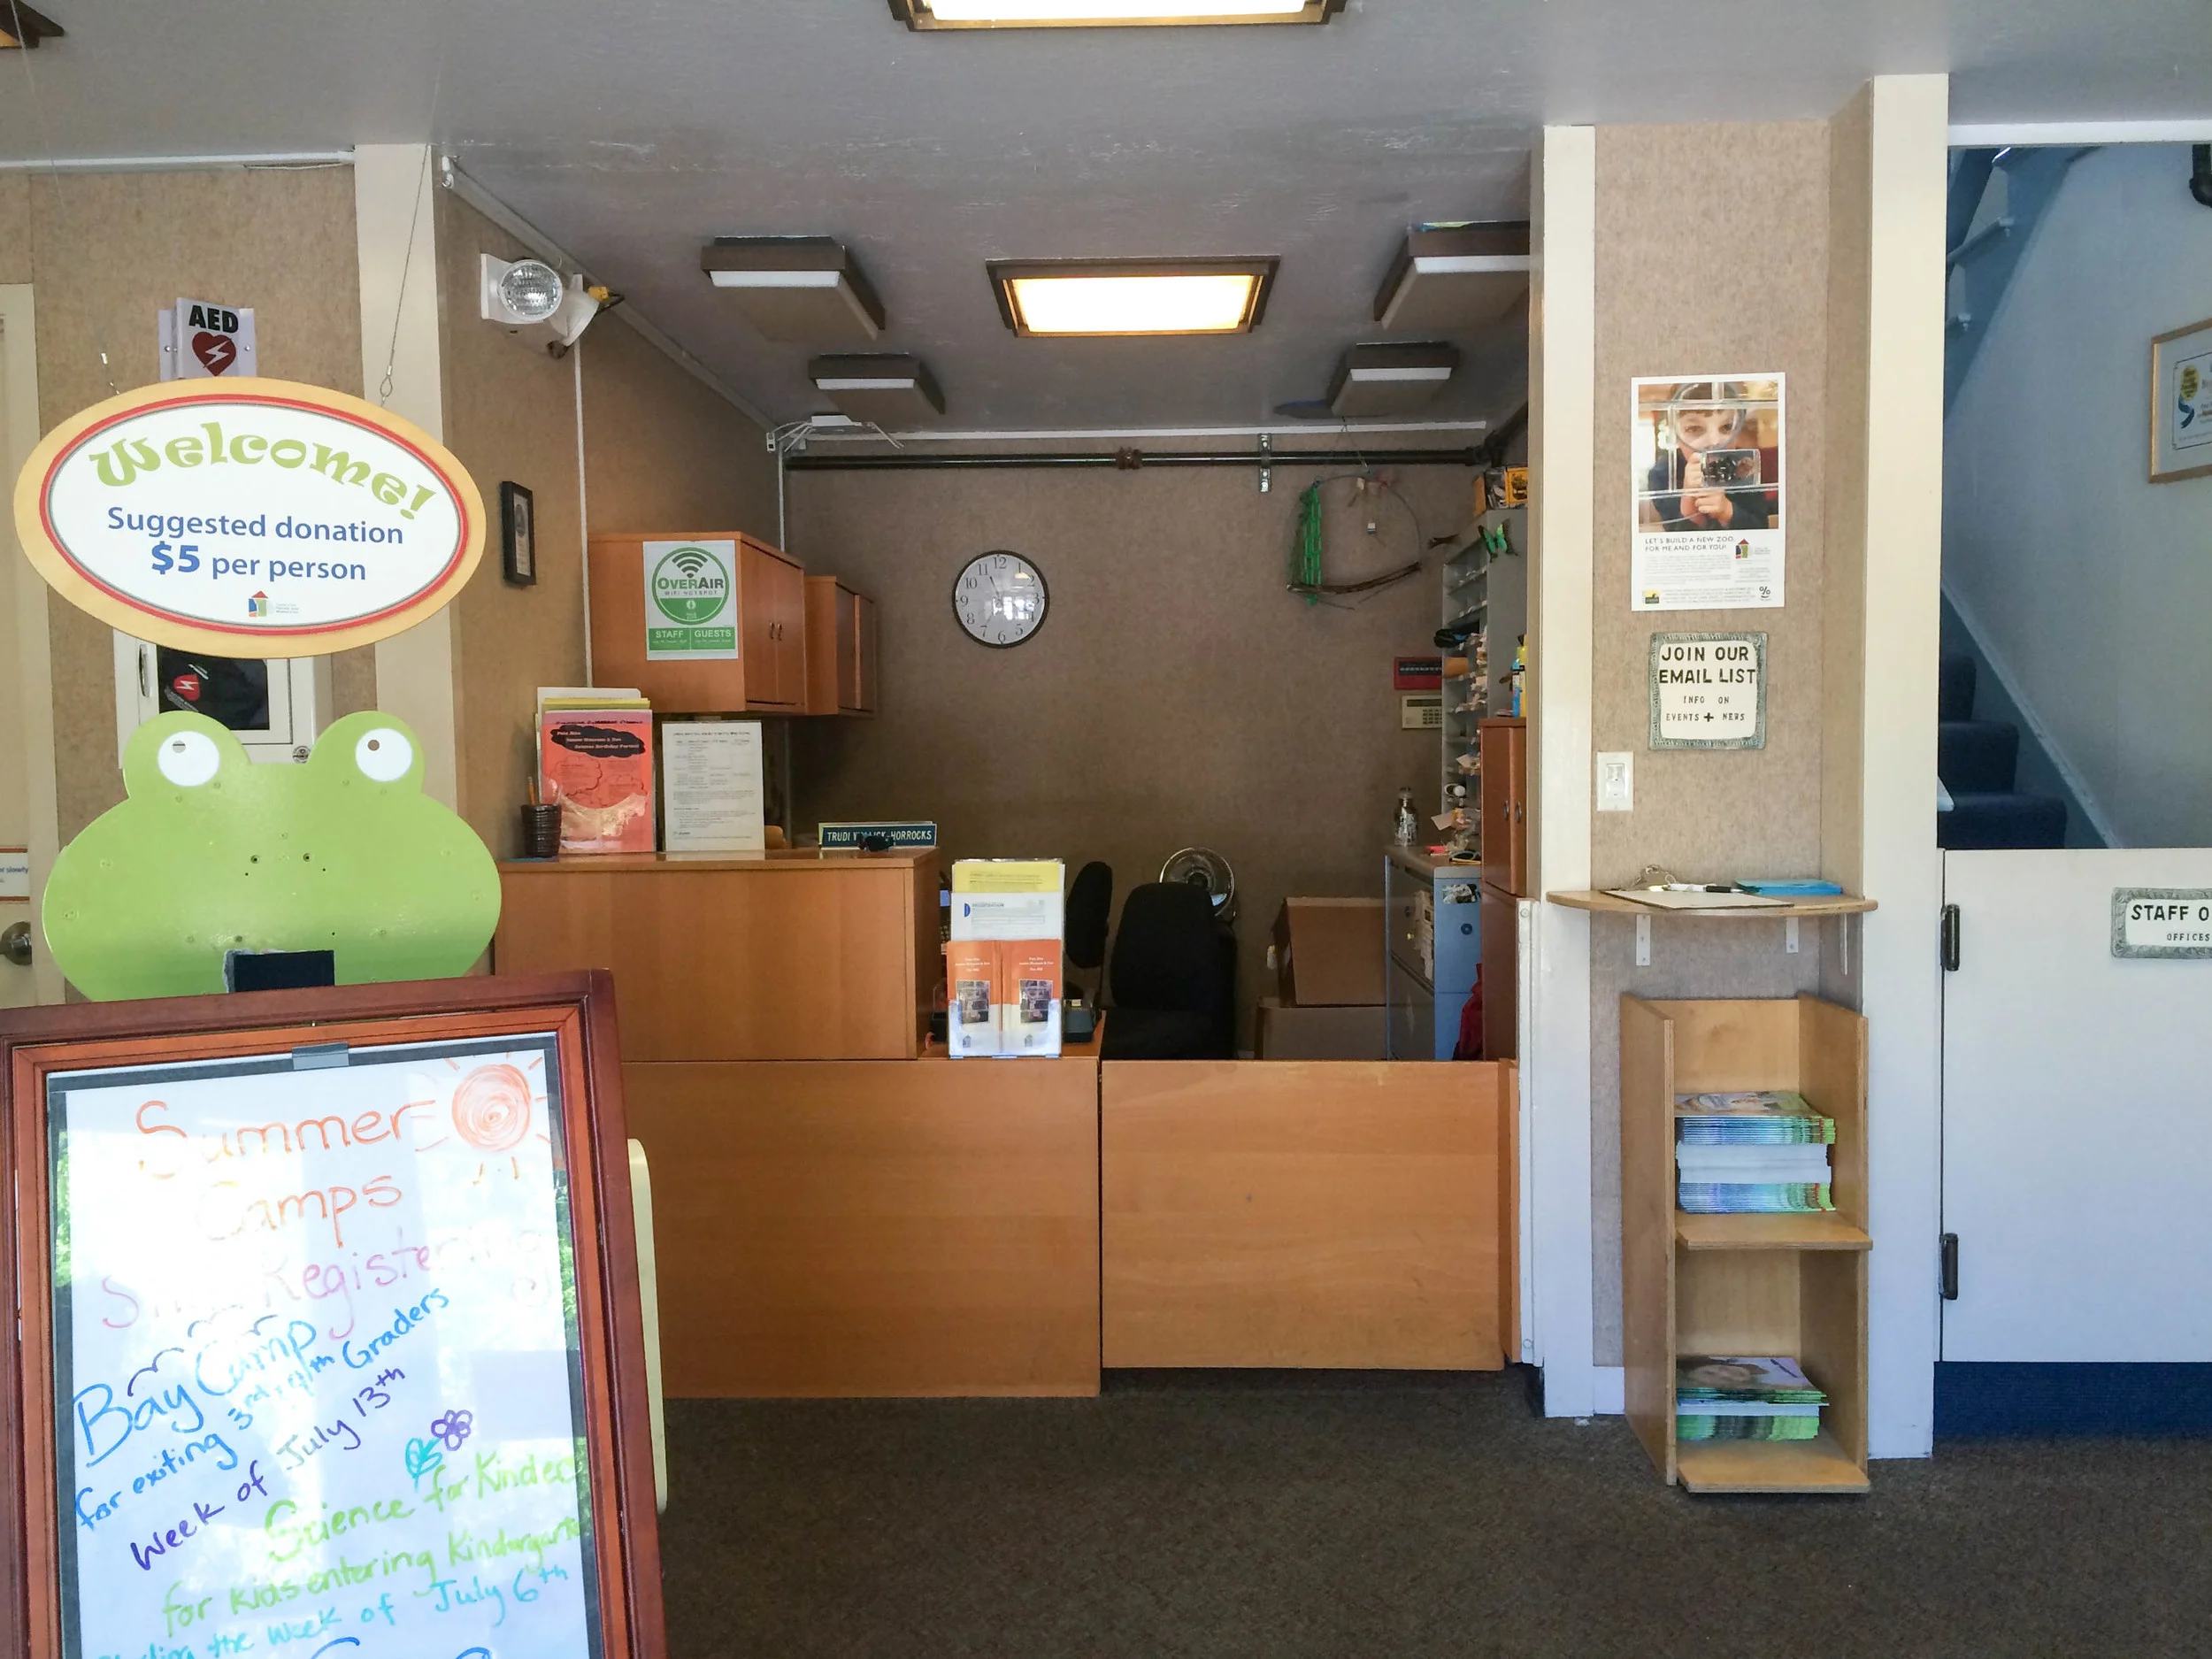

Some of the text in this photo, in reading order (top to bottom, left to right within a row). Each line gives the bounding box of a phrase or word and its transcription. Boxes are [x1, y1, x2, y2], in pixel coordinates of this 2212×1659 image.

[188, 305, 238, 333] AED
[89, 421, 436, 519] Welcome!
[108, 507, 403, 544] Suggested donation
[151, 541, 366, 581] $5 per person
[994, 557, 1007, 569] 12
[978, 564, 988, 575] 11
[965, 577, 977, 589] 10
[1027, 574, 1035, 587] 2
[960, 595, 969, 607] 9
[1033, 592, 1040, 604] 3
[966, 612, 975, 625] 8
[980, 625, 987, 637] 7
[997, 630, 1006, 644] 6
[1015, 623, 1024, 636] 5
[1662, 646, 1748, 661] JOIN OUR
[1659, 668, 1755, 684] EMAIL LIST
[1722, 712, 1745, 721] NEWS
[827, 832, 850, 841] TRUDI
[2131, 904, 2189, 921] STAFF
[2166, 933, 2210, 941] OFFICES
[135, 1099, 435, 1179] Summer
[195, 1175, 403, 1248] Camps
[73, 1320, 317, 1467] Bay Camp
[74, 1486, 122, 1531] for
[134, 1432, 238, 1494] exiting
[342, 1287, 449, 1368] Graders
[237, 1459, 268, 1502] of
[276, 1419, 361, 1471] July
[353, 1367, 406, 1417] 13th
[265, 1499, 416, 1563] Science
[424, 1465, 470, 1512] for
[361, 1593, 396, 1626] of
[429, 1576, 505, 1628] July
[513, 1564, 569, 1602] 6th
[163, 1580, 212, 1639] for
